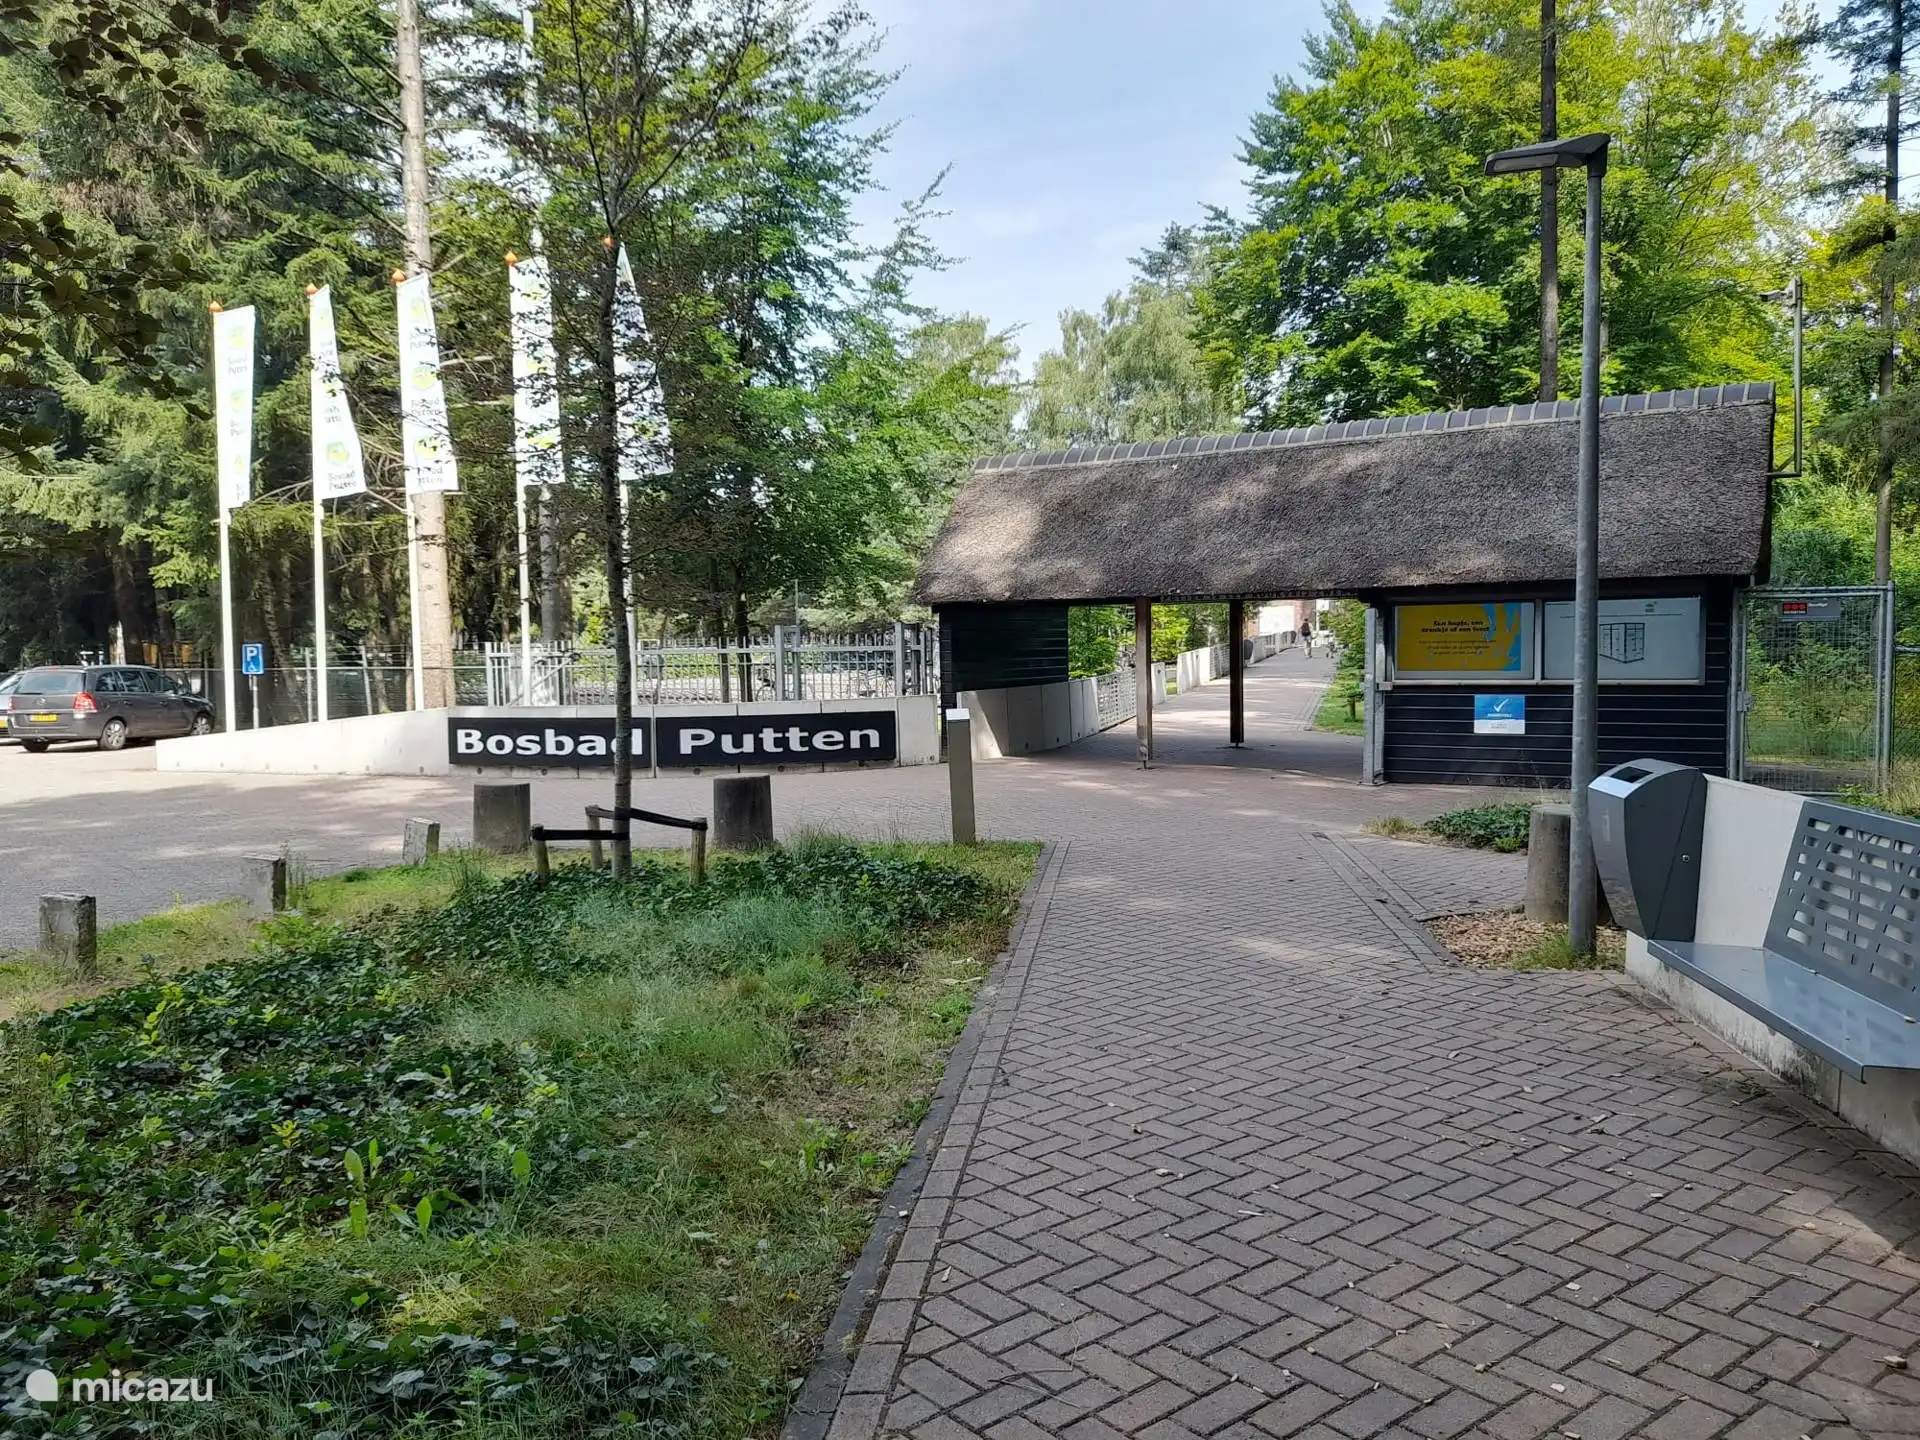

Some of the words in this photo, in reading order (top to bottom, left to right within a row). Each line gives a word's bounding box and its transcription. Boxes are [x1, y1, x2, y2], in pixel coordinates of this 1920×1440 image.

[247, 646, 258, 661] P
[456, 727, 643, 757] Bosbad
[679, 726, 881, 755] Putten
